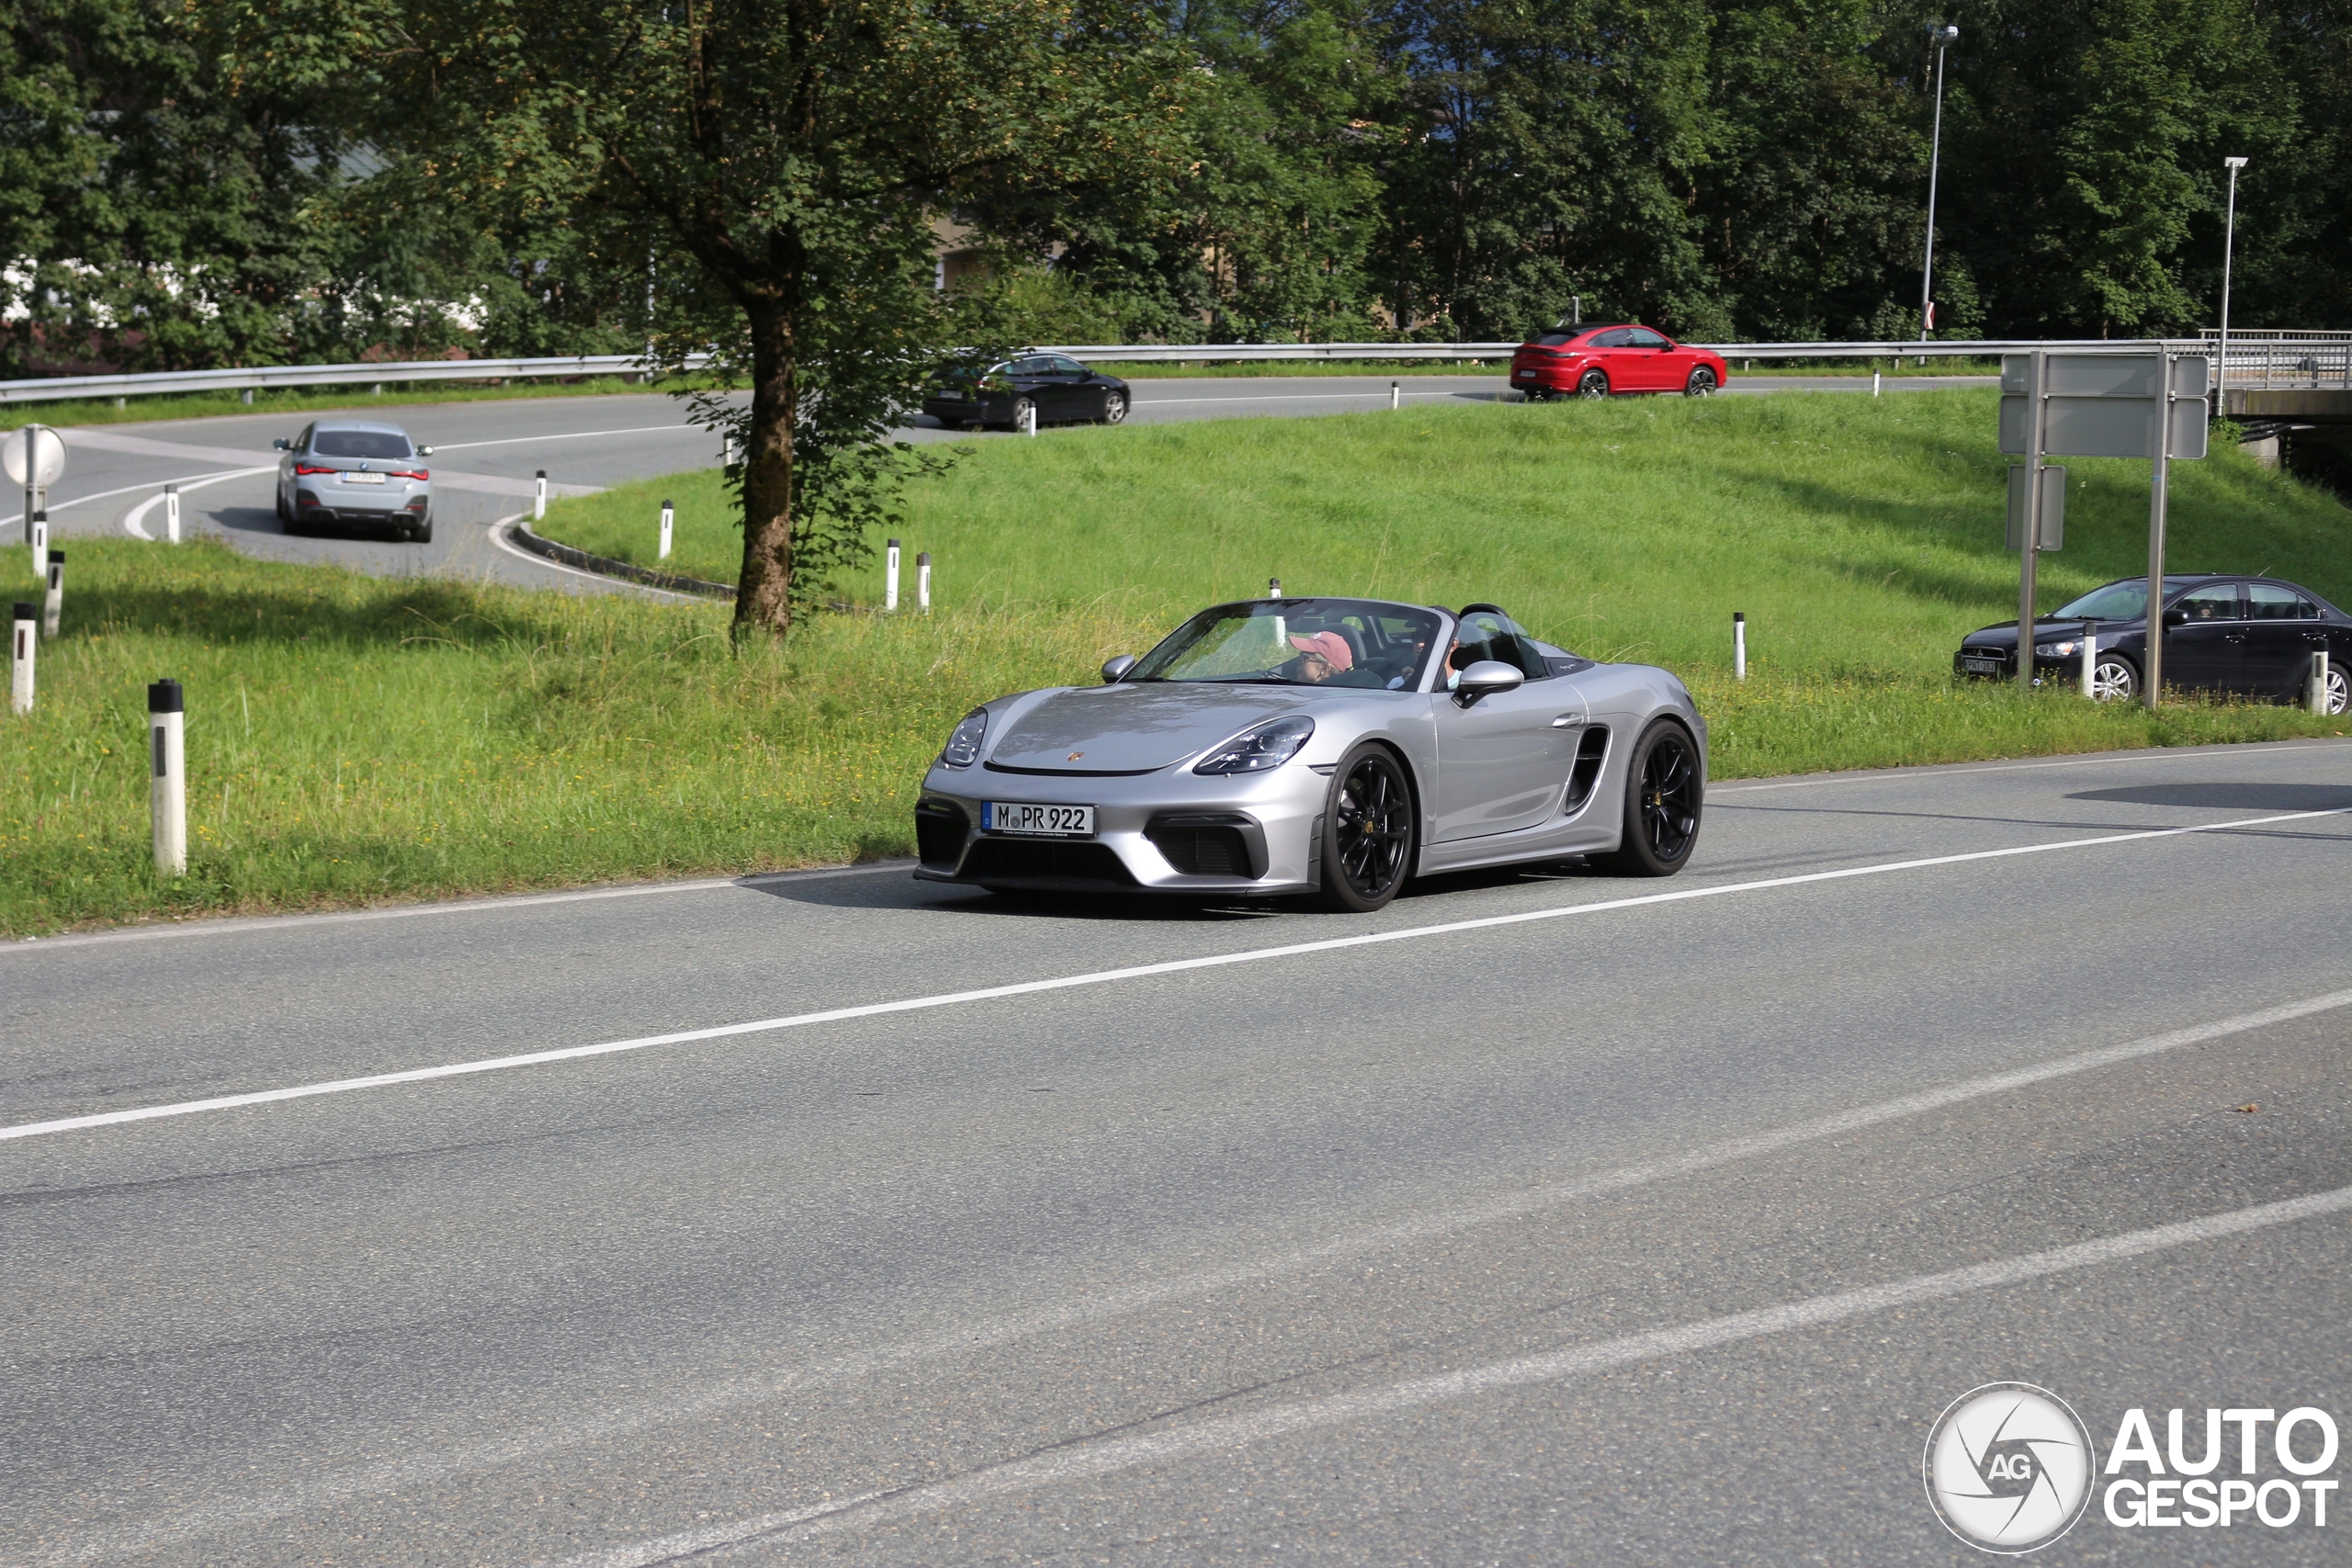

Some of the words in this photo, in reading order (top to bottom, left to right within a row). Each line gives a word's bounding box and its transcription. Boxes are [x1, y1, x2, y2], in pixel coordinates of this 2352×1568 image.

[1968, 660, 1995, 671] PNT-262
[998, 806, 1010, 827] M
[1021, 807, 1045, 829] PR
[1049, 808, 1085, 830] 922
